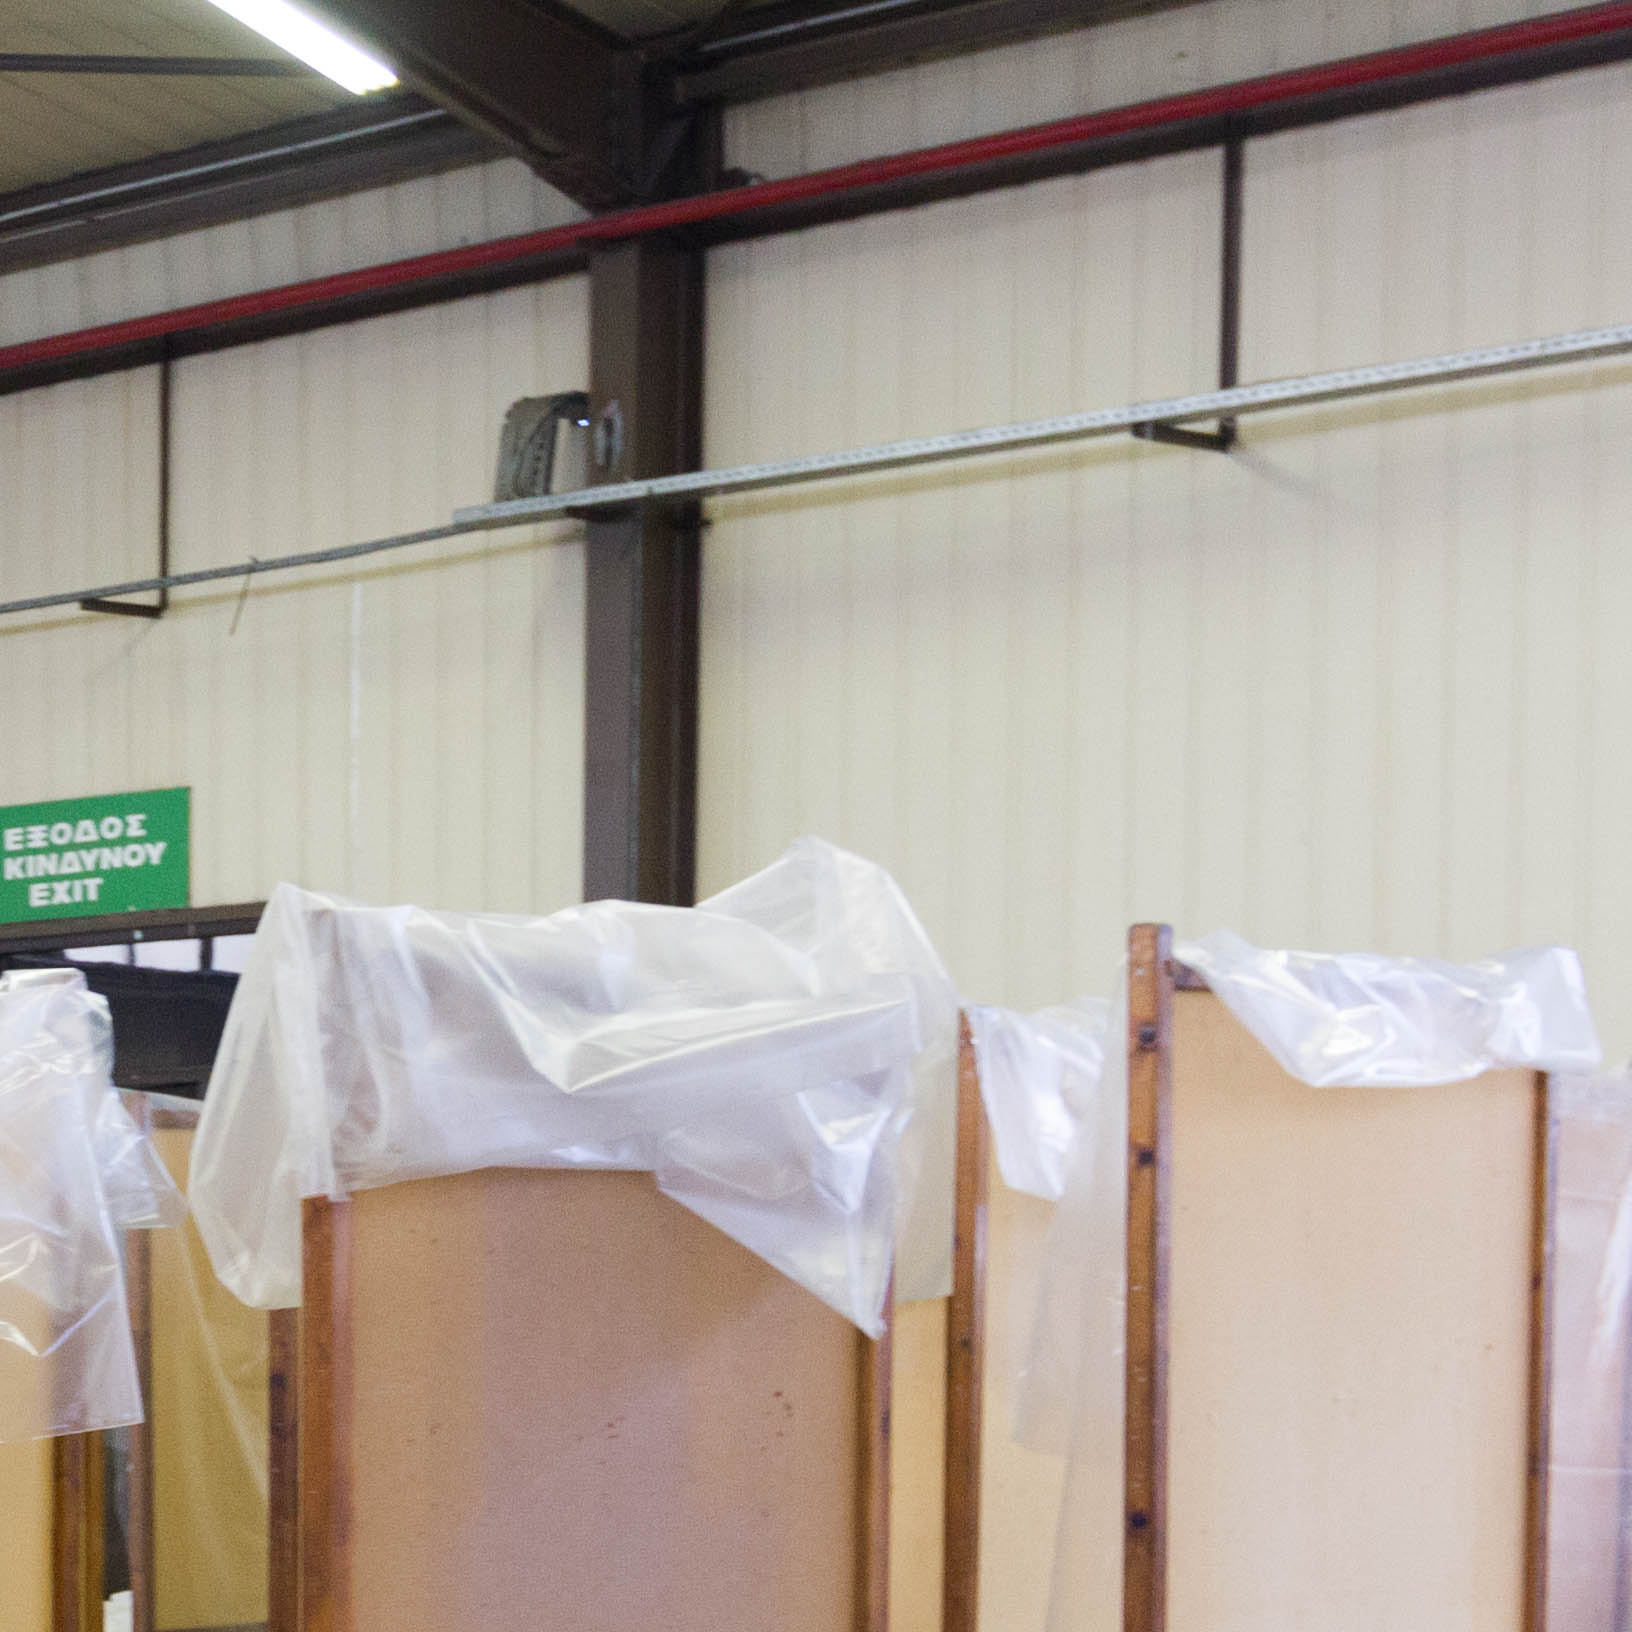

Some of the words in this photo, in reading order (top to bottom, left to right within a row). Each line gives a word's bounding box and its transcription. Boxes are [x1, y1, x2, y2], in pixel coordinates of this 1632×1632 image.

[4, 813, 147, 851] ΕΞΟΔΟΣ
[3, 842, 167, 880] ΚΙΝΔΥΝΟΥ
[30, 878, 104, 907] EXIT
